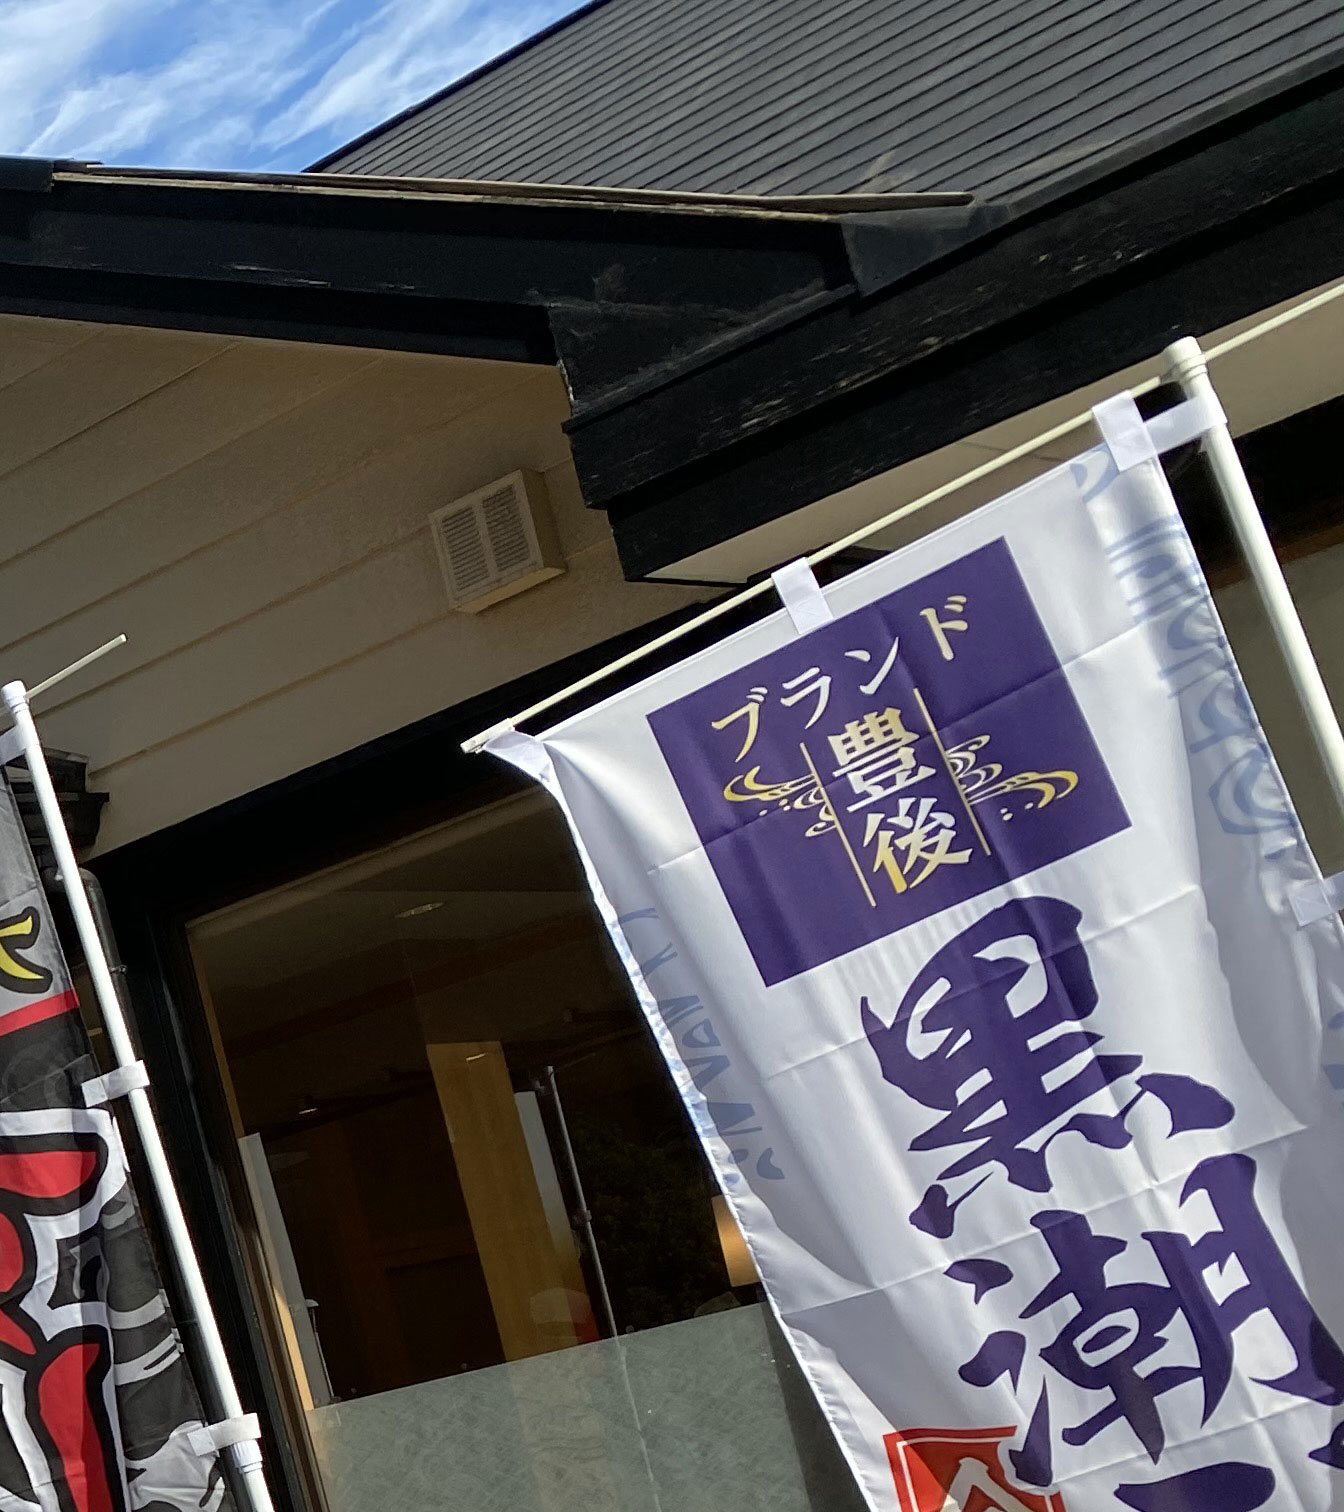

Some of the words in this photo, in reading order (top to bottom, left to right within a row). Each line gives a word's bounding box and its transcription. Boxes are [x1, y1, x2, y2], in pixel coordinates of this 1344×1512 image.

[711, 594, 970, 763] ブランド
[827, 705, 973, 894] 豊後
